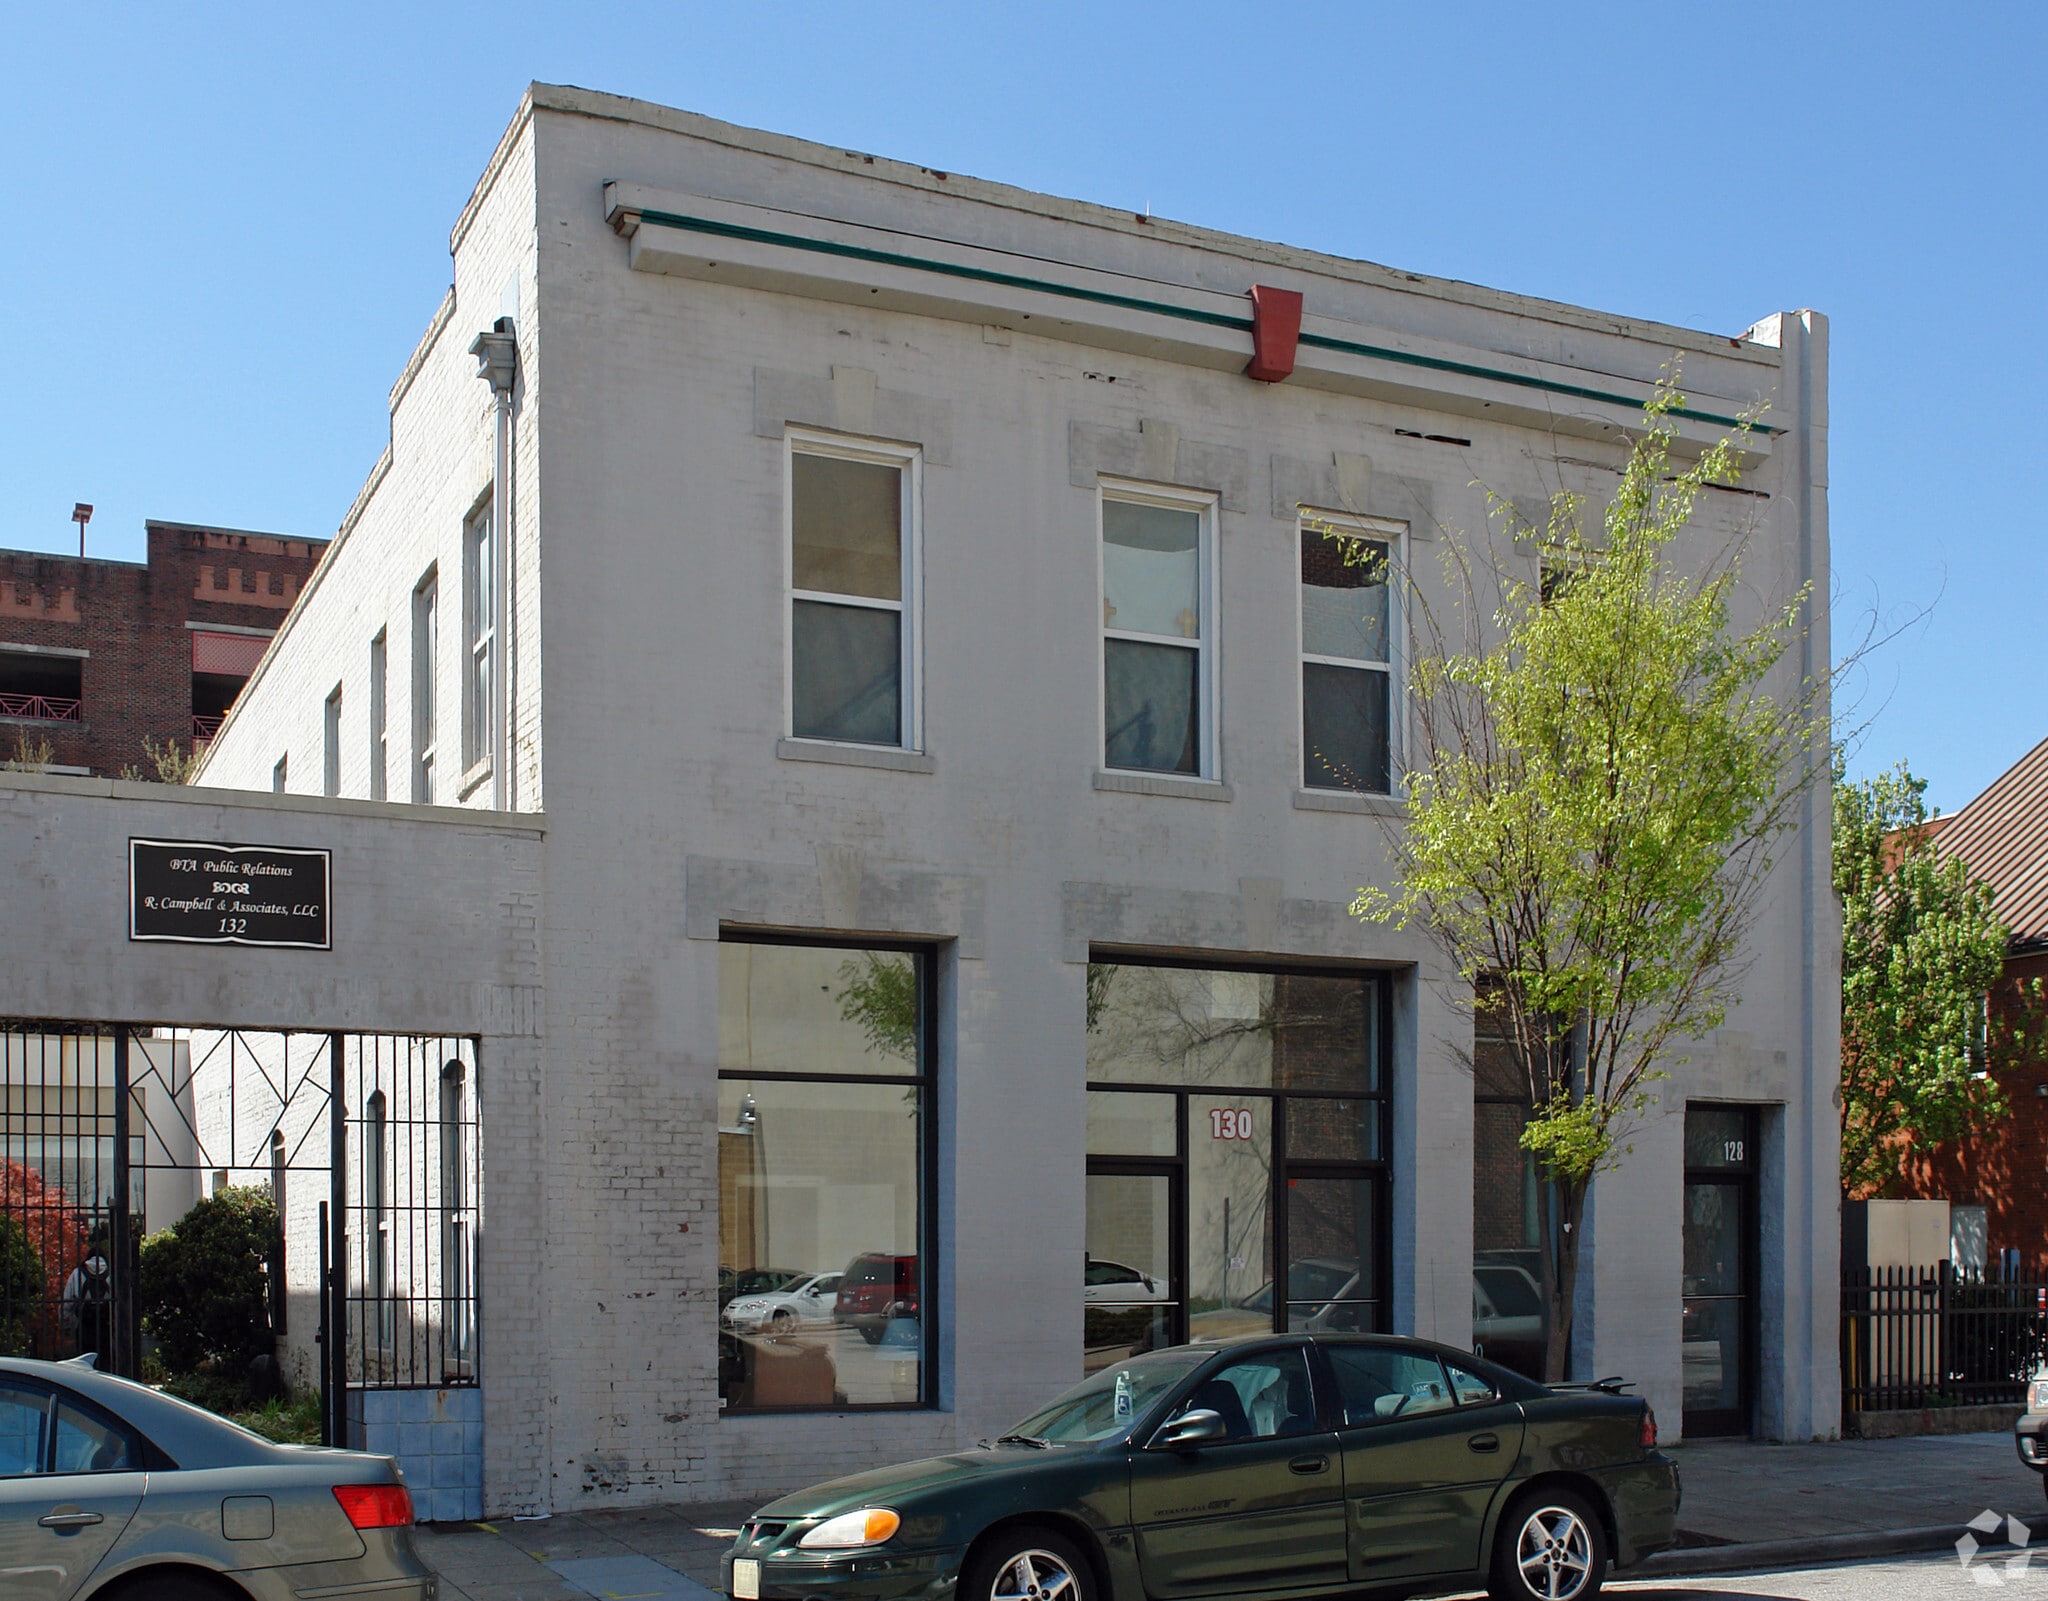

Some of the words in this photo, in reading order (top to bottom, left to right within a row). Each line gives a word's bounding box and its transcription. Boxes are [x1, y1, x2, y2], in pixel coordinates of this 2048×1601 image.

[203, 860, 239, 874] Public
[241, 862, 293, 877] Relations
[161, 897, 214, 914] Campbell
[217, 899, 227, 911] &
[229, 900, 289, 916] Associates,
[292, 904, 319, 917] LLC
[218, 918, 247, 934] 132
[1209, 1108, 1253, 1140] 130
[1723, 1141, 1744, 1161] 128
